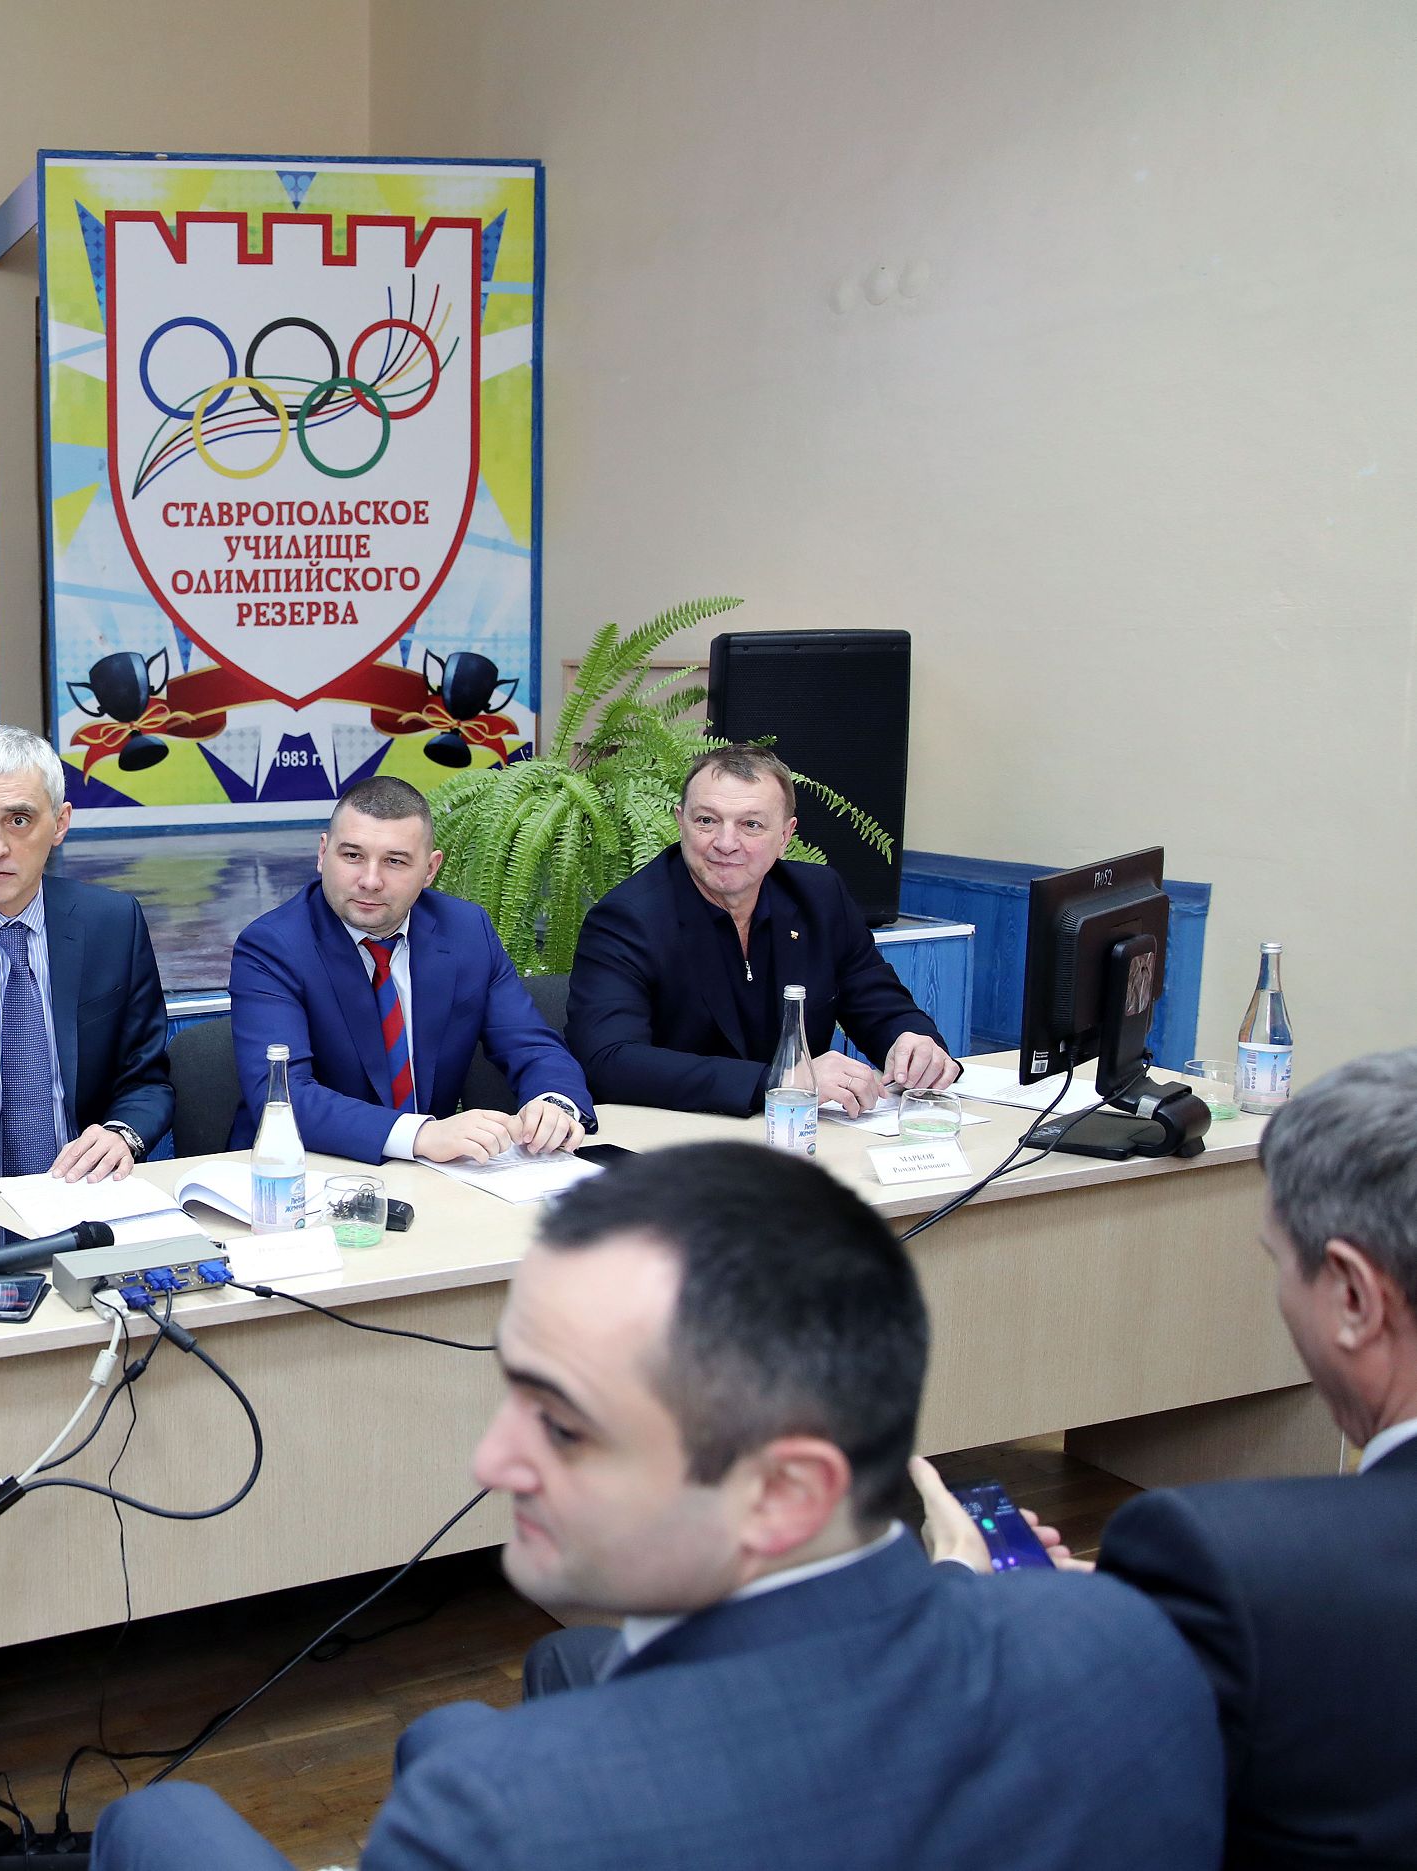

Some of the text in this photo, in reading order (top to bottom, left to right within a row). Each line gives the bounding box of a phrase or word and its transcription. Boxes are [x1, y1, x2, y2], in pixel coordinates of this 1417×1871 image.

[162, 500, 430, 527] СТАВРОПОЛЬСКОЕ
[224, 534, 371, 562] УЧИЛИЩЕ
[171, 561, 421, 595] ОЛИМПИЙСКОГО
[236, 601, 359, 627] РЕЗЕРВА
[275, 750, 308, 768] 1983
[899, 1153, 935, 1162] МАРКОВ
